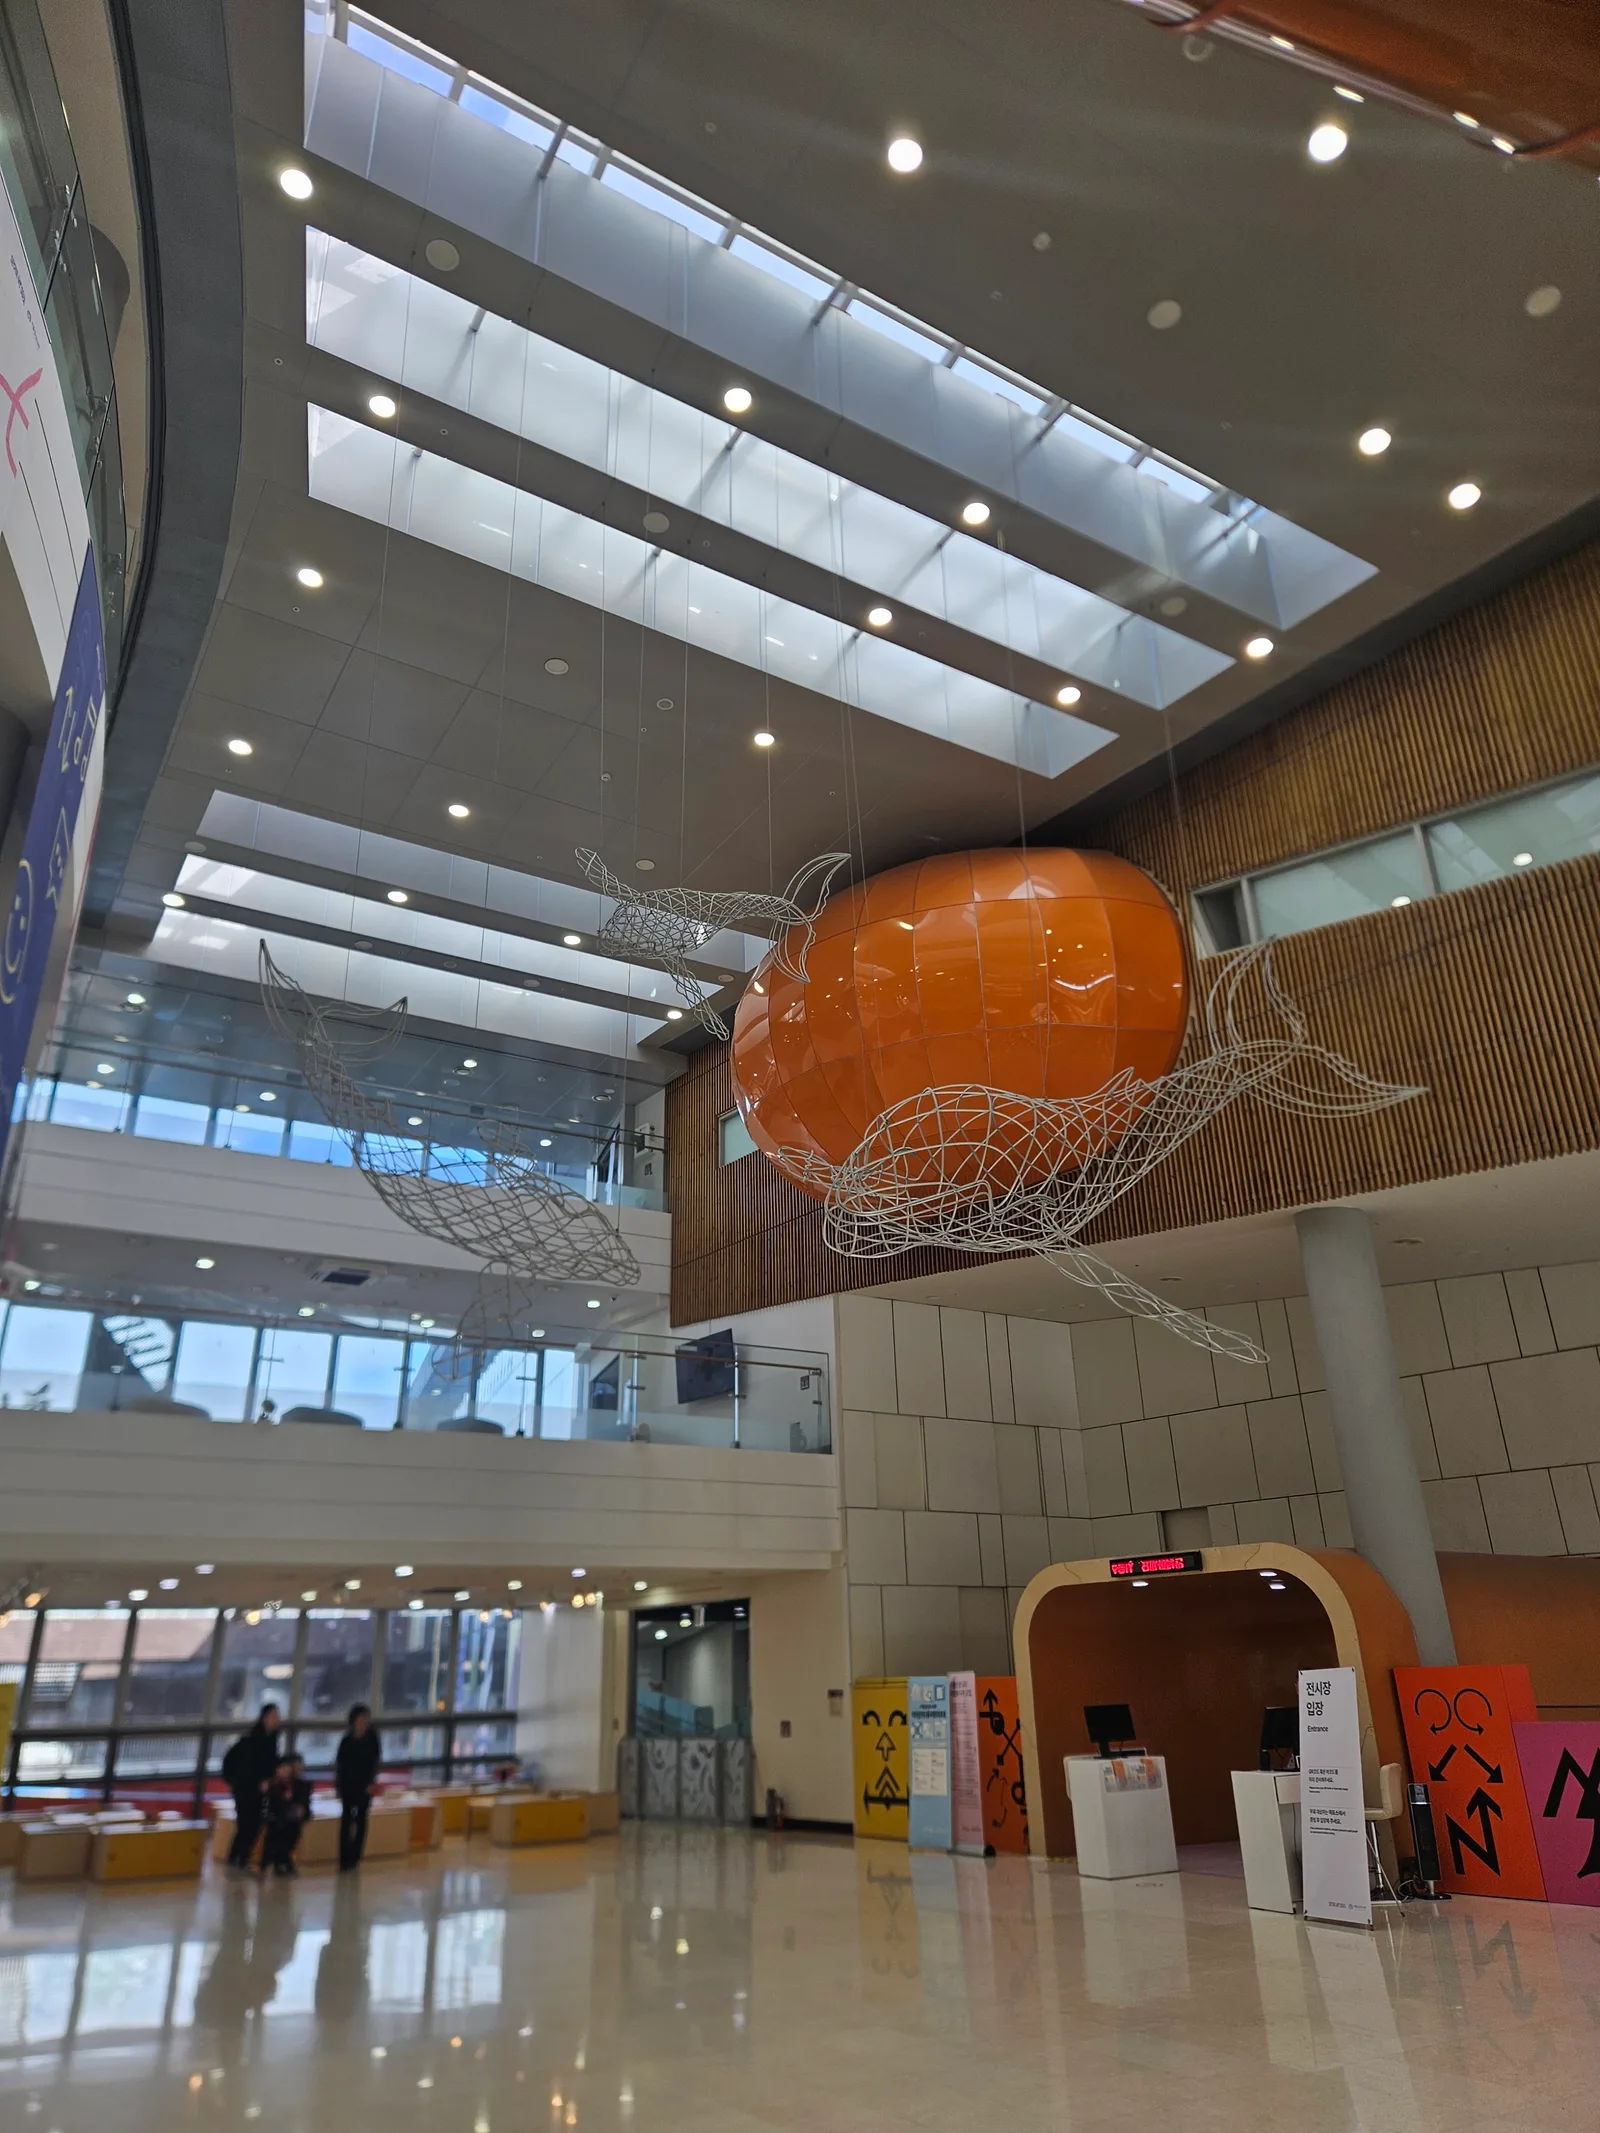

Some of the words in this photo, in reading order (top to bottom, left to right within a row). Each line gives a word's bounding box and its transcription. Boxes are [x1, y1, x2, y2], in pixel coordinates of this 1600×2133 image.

[1306, 1681, 1331, 1696] 전시장
[1306, 1701, 1324, 1716] 입장
[1307, 1725, 1329, 1733] Entrance
